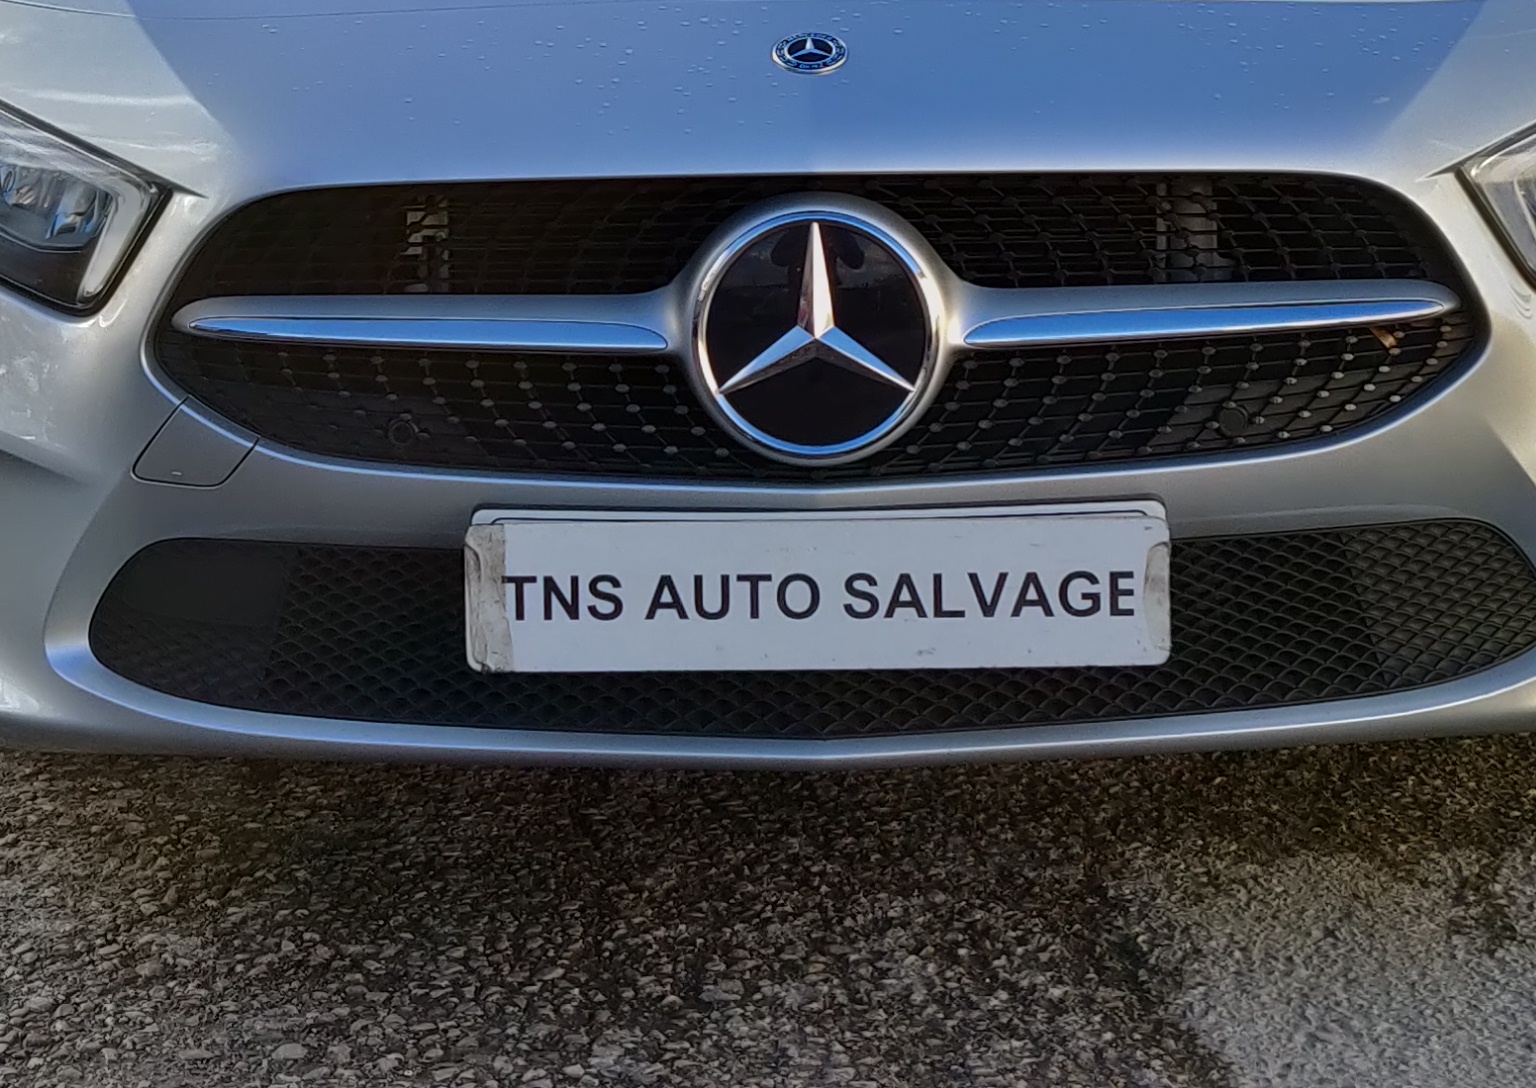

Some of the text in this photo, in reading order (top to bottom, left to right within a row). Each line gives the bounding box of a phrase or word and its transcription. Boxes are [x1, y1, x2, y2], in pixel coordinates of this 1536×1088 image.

[501, 569, 1135, 622] TNS AUTO SALVAGE
